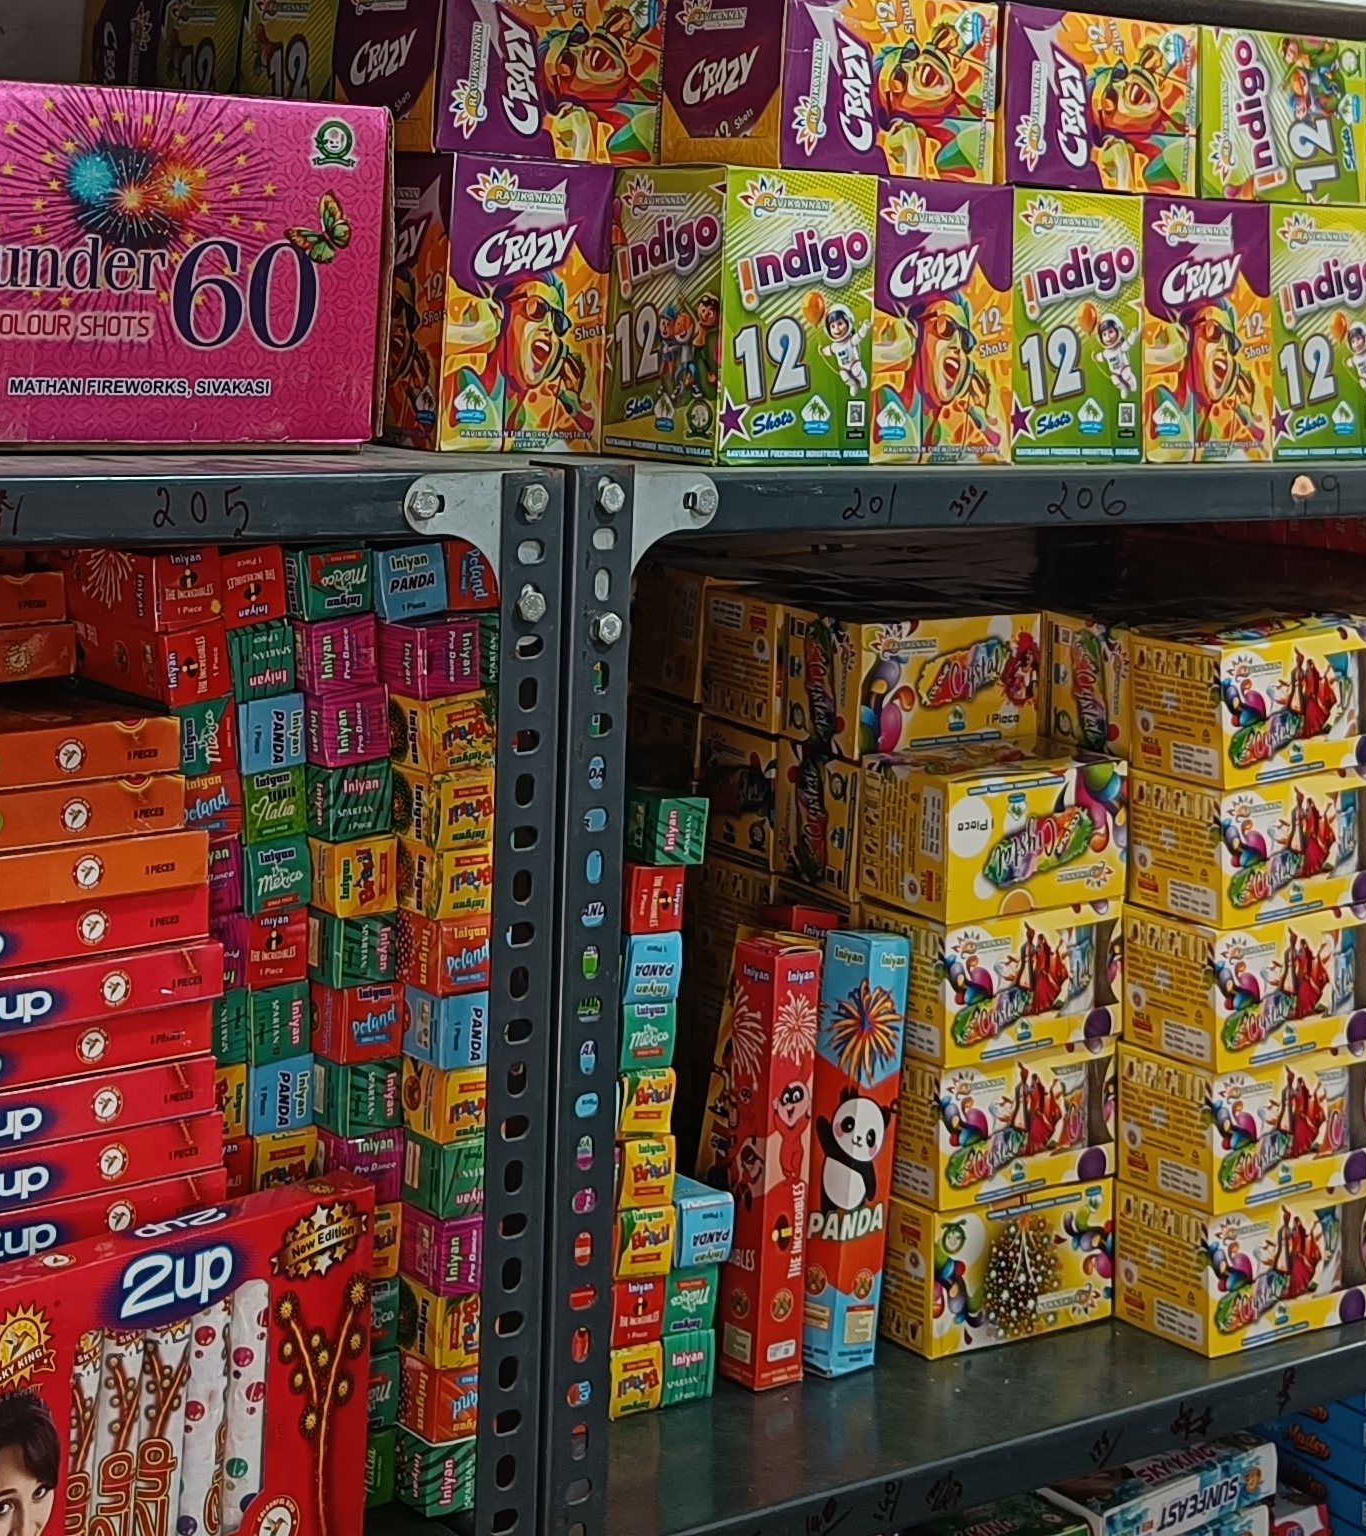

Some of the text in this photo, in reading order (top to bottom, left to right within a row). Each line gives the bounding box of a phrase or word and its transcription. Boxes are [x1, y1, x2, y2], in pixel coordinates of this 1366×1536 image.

[348, 28, 416, 86] CRAZY
[500, 10, 540, 136] CRAZY
[682, 47, 760, 105] CRAZY
[837, 29, 875, 152] CRAZY
[495, 188, 565, 208] RAVIKANNAN
[762, 195, 830, 215] RAVIKANNAN
[473, 225, 579, 279] CRAZY
[888, 245, 981, 300] CRAZY
[170, 237, 319, 351] 60
[573, 289, 601, 318] 12
[1161, 254, 1242, 305] CRAZY
[78, 313, 151, 338] SHOTS
[573, 324, 604, 342] Shots
[977, 306, 1003, 336] 12
[734, 316, 810, 405] 12
[979, 339, 1009, 358] Shots
[1018, 324, 1084, 404] 12
[1279, 335, 1339, 410] 12
[7, 376, 271, 399] MATHAN FIREWORKS, SIVAKASI
[752, 411, 795, 436] Shots
[153, 485, 250, 538] 205
[1046, 480, 1128, 519] 206
[390, 571, 435, 593] PANDA
[272, 710, 284, 764] PANDA
[787, 970, 815, 982] Iniyan
[291, 1221, 356, 1260] New Edition
[787, 1182, 805, 1278] THE INCREDIBLES
[807, 1204, 883, 1241] PANDA
[118, 1243, 234, 1320] 2up
[17, 1348, 43, 1369] KING
[1157, 1476, 1239, 1529] SUNFEAST
